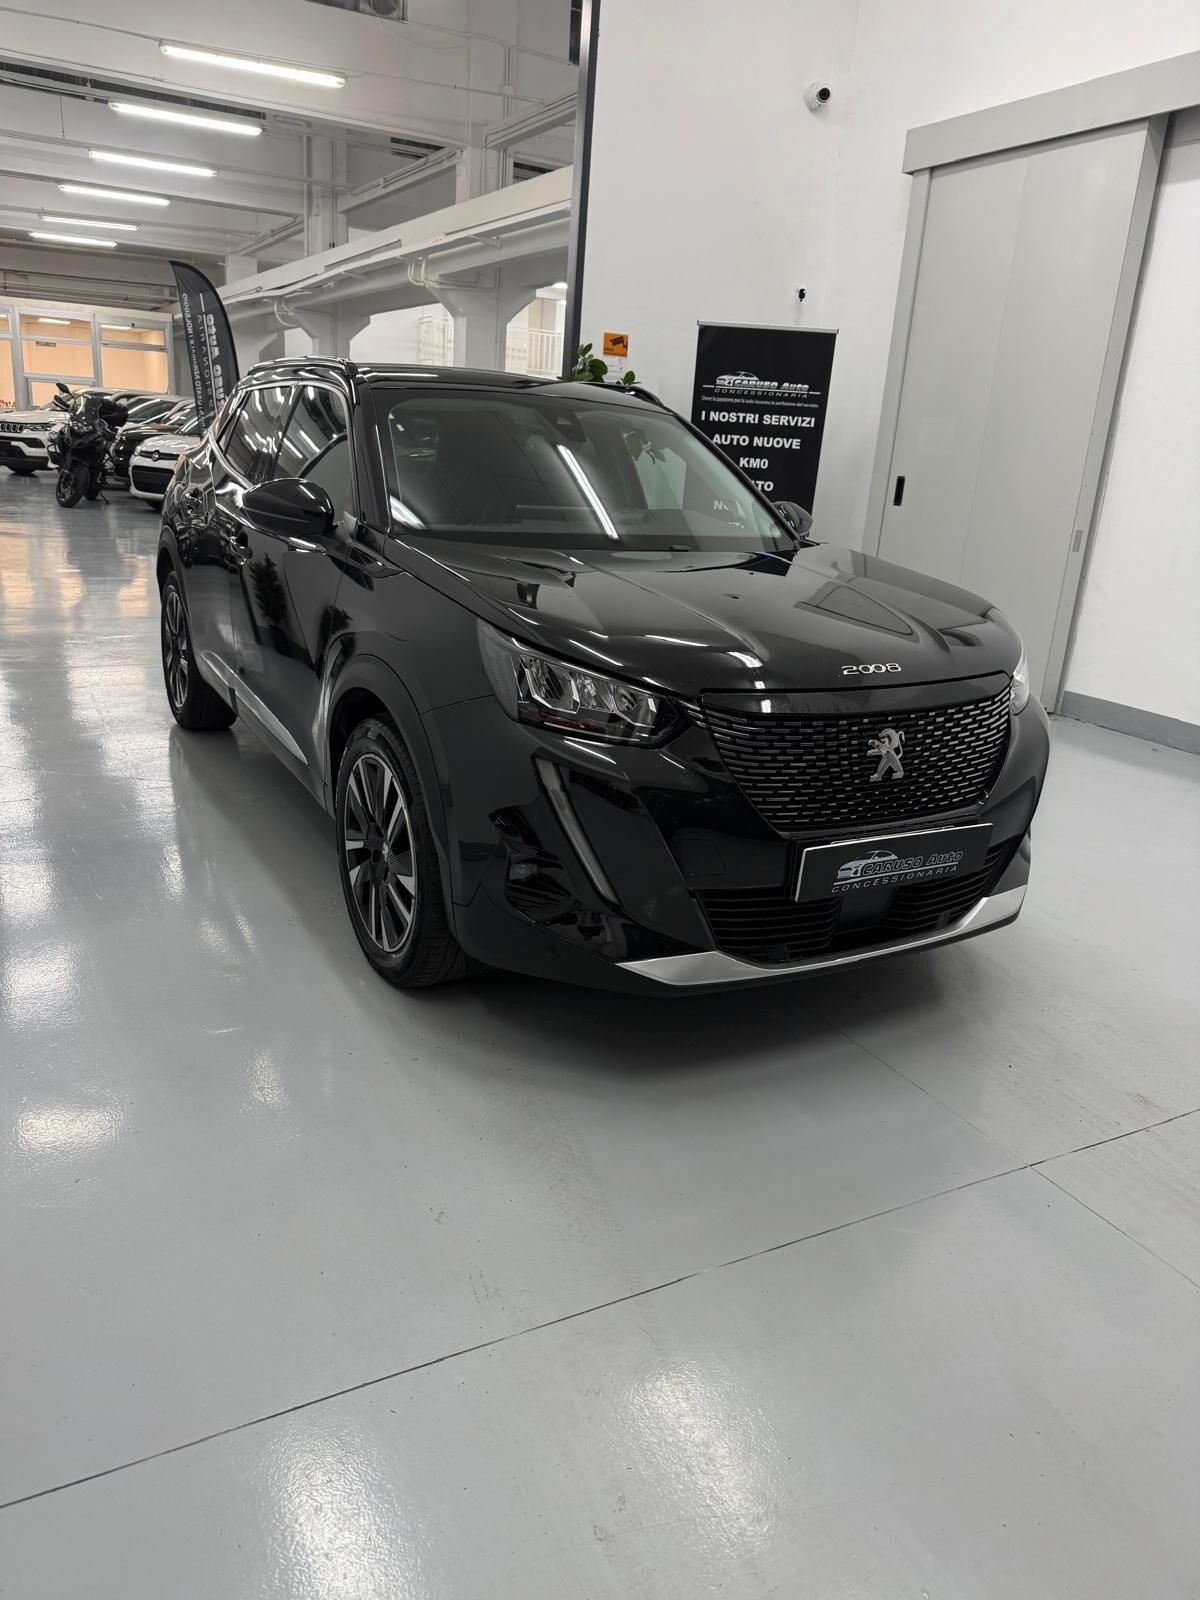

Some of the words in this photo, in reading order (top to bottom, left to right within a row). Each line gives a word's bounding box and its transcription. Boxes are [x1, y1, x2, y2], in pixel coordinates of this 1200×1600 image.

[780, 382, 810, 391] Auto
[714, 388, 808, 399] CONCESSIONARIA
[701, 411, 706, 421] I
[709, 411, 759, 424] NOSTRI
[762, 414, 815, 428] SERVIZI
[712, 434, 749, 446] AUTO
[753, 436, 801, 449] NUOVE
[739, 457, 769, 469] KM0
[842, 663, 901, 675] 2008
[862, 856, 923, 876] CARUSO
[926, 851, 963, 866] Auto
[831, 865, 958, 893] CONCESSIONARIA
